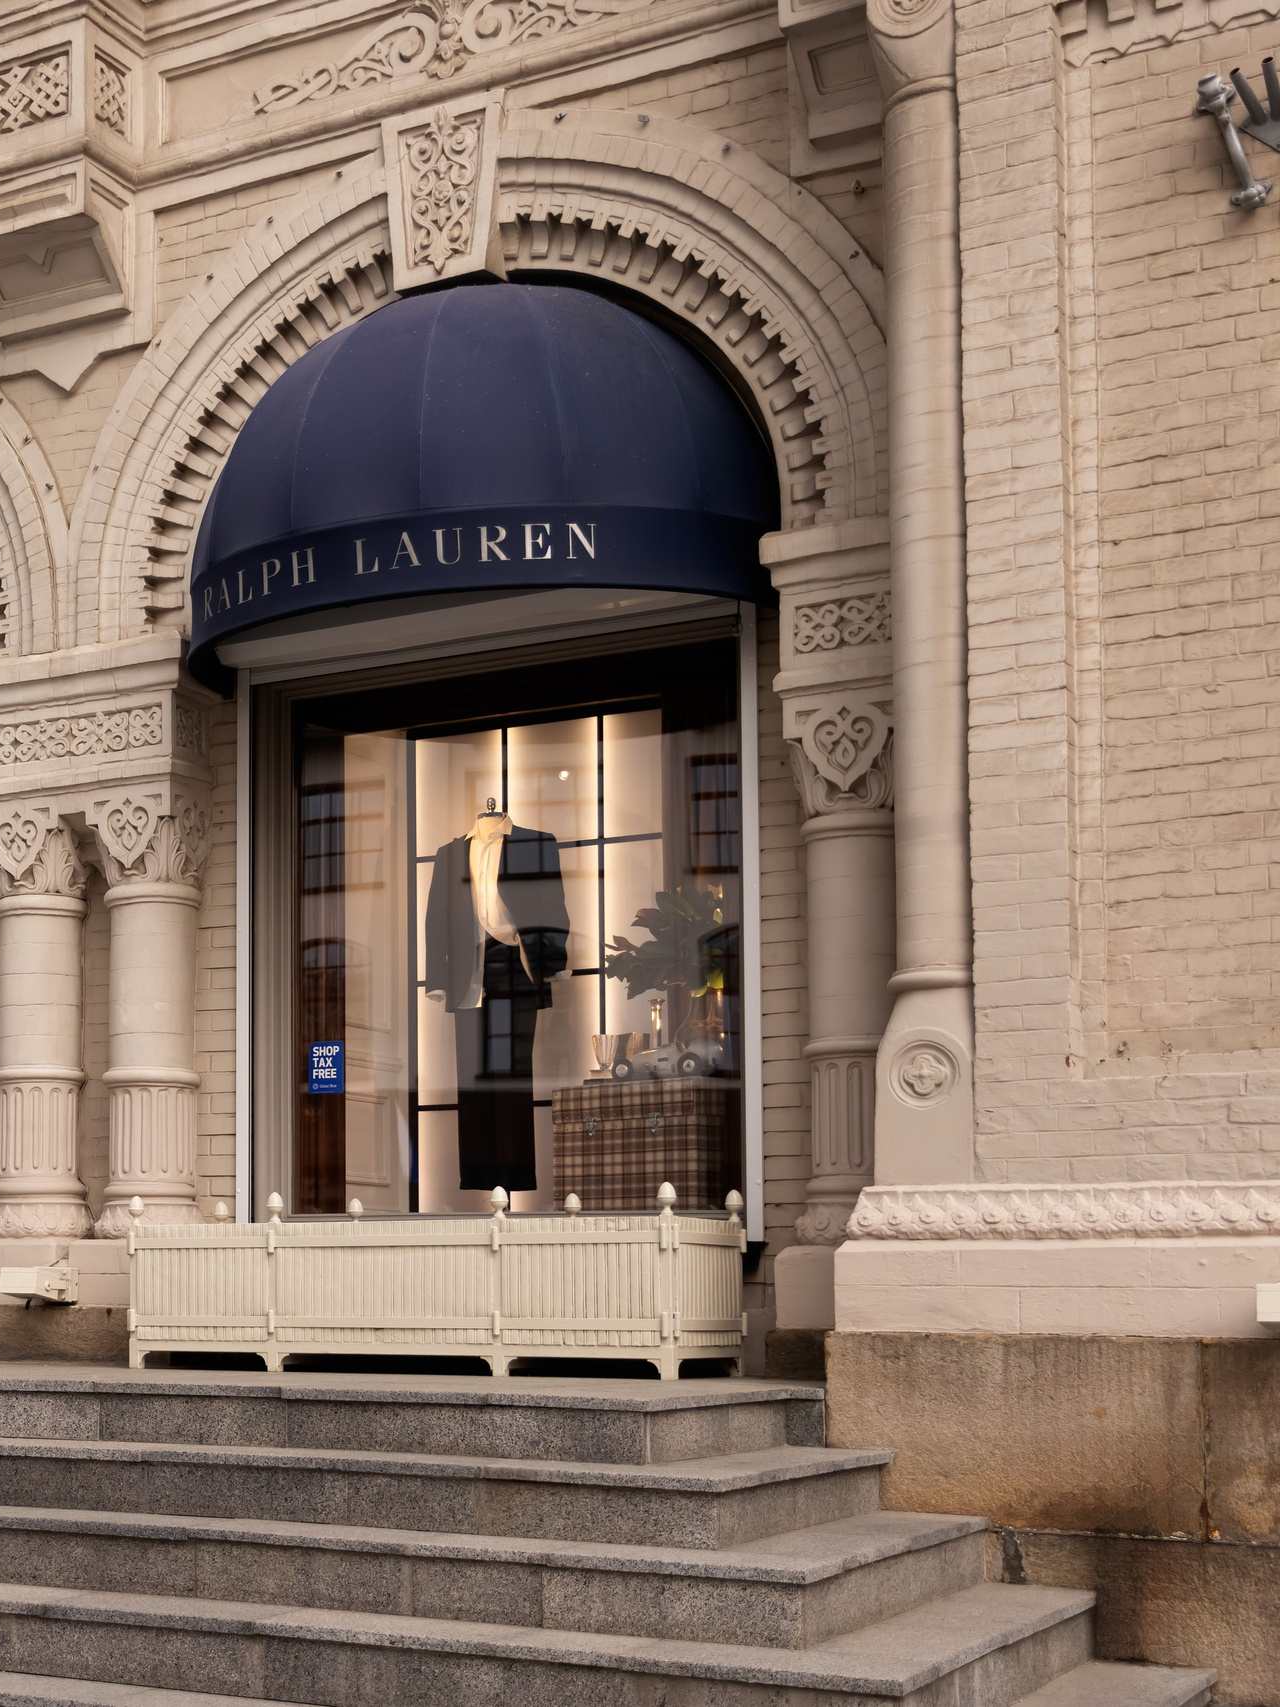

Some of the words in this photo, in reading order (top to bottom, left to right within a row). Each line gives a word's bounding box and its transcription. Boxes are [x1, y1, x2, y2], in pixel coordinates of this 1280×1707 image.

[203, 547, 317, 622] RALPH
[353, 523, 597, 576] LAUREN
[312, 1045, 340, 1057] SHOP
[312, 1057, 333, 1068] TAX
[312, 1068, 337, 1079] FREE
